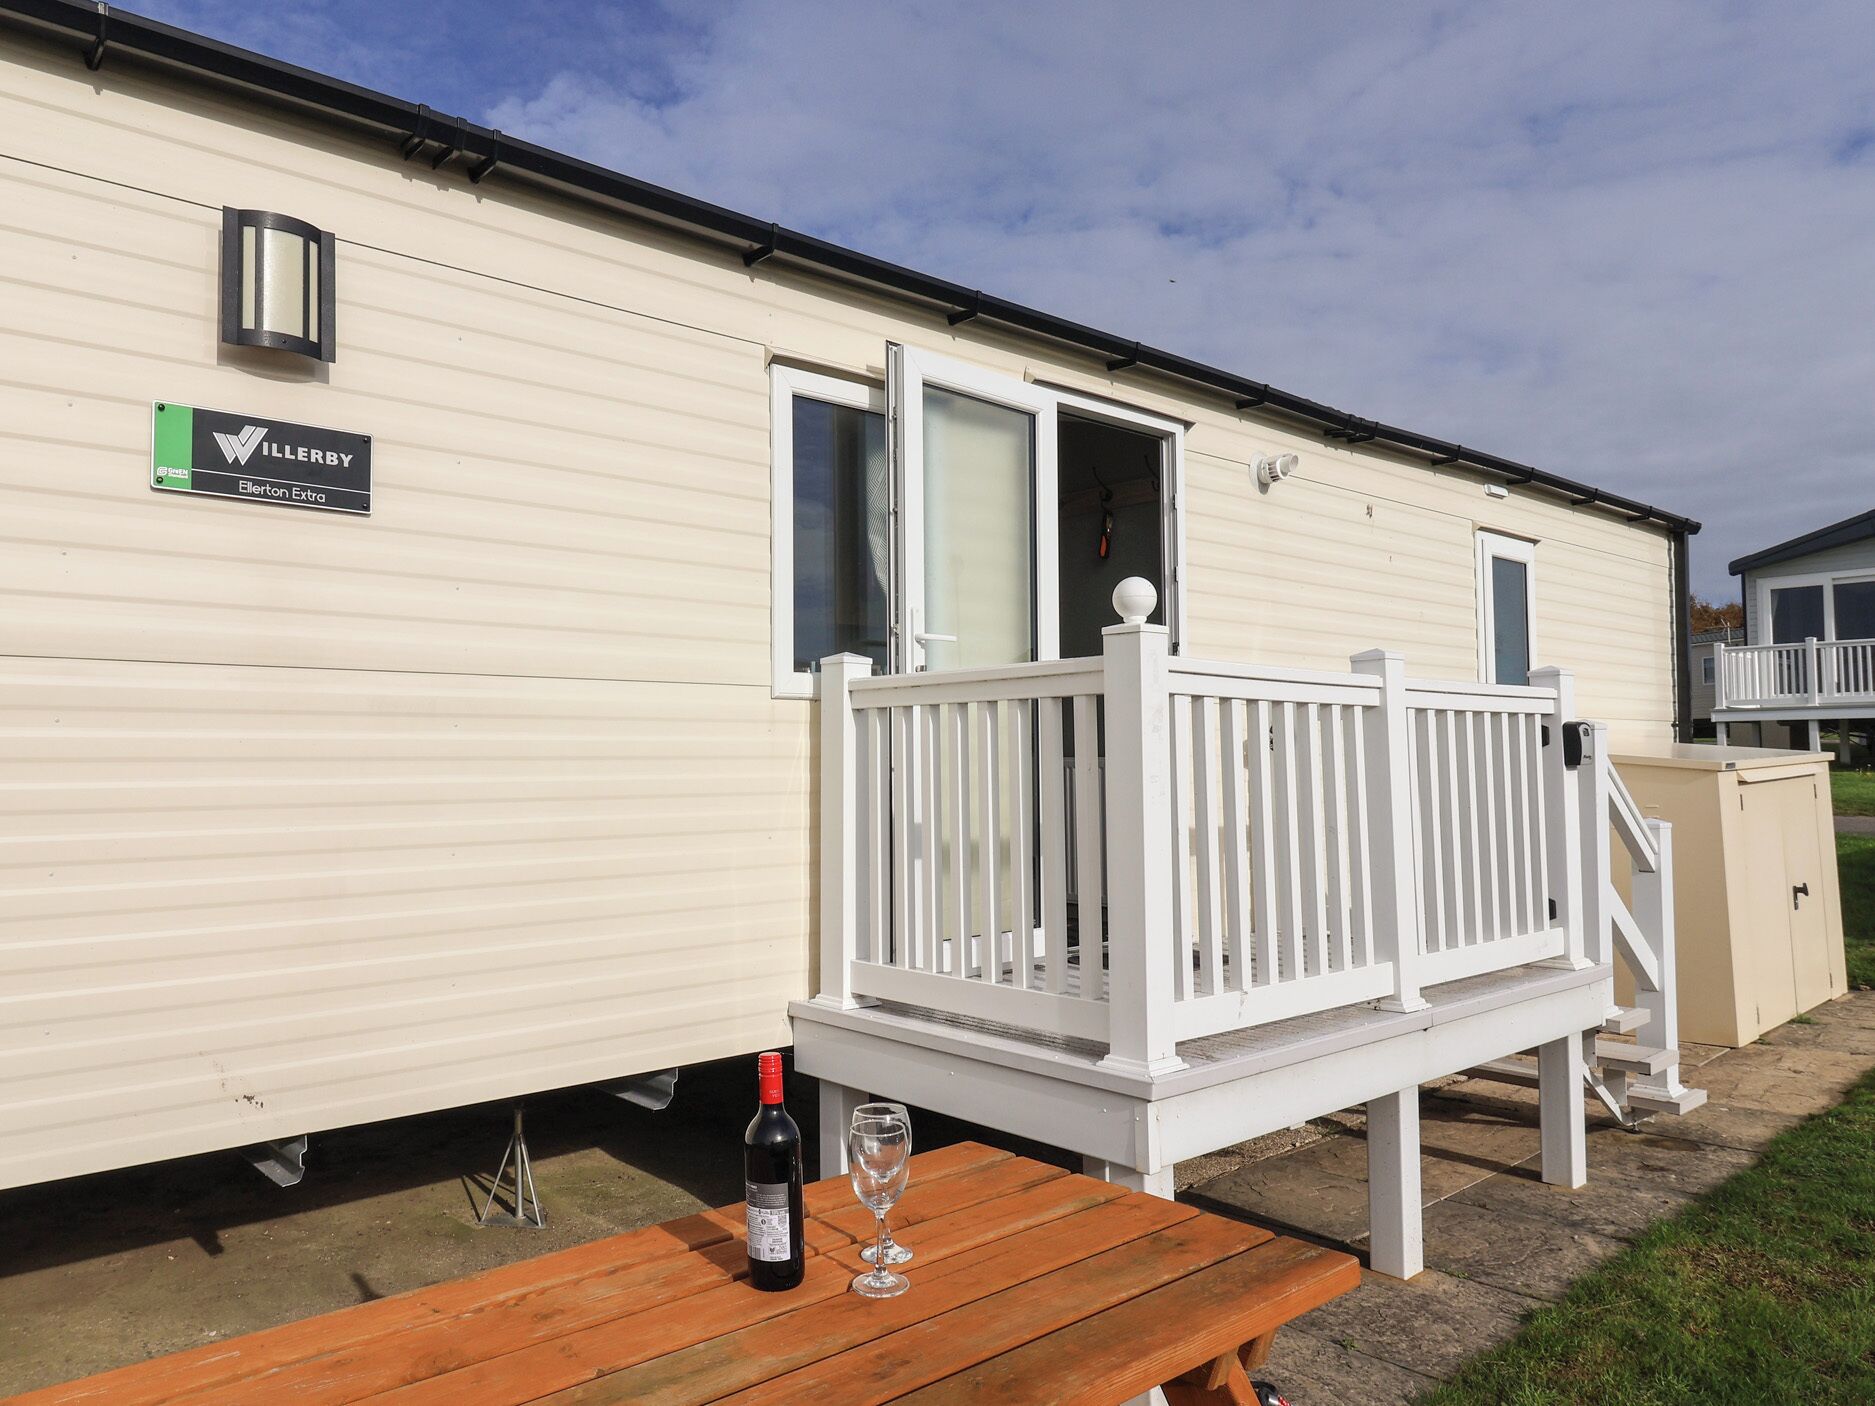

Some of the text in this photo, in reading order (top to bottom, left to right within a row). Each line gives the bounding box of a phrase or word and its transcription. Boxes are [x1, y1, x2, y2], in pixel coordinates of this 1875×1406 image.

[213, 425, 353, 468] WILLERBY
[239, 480, 326, 503] Ellerton Extra
